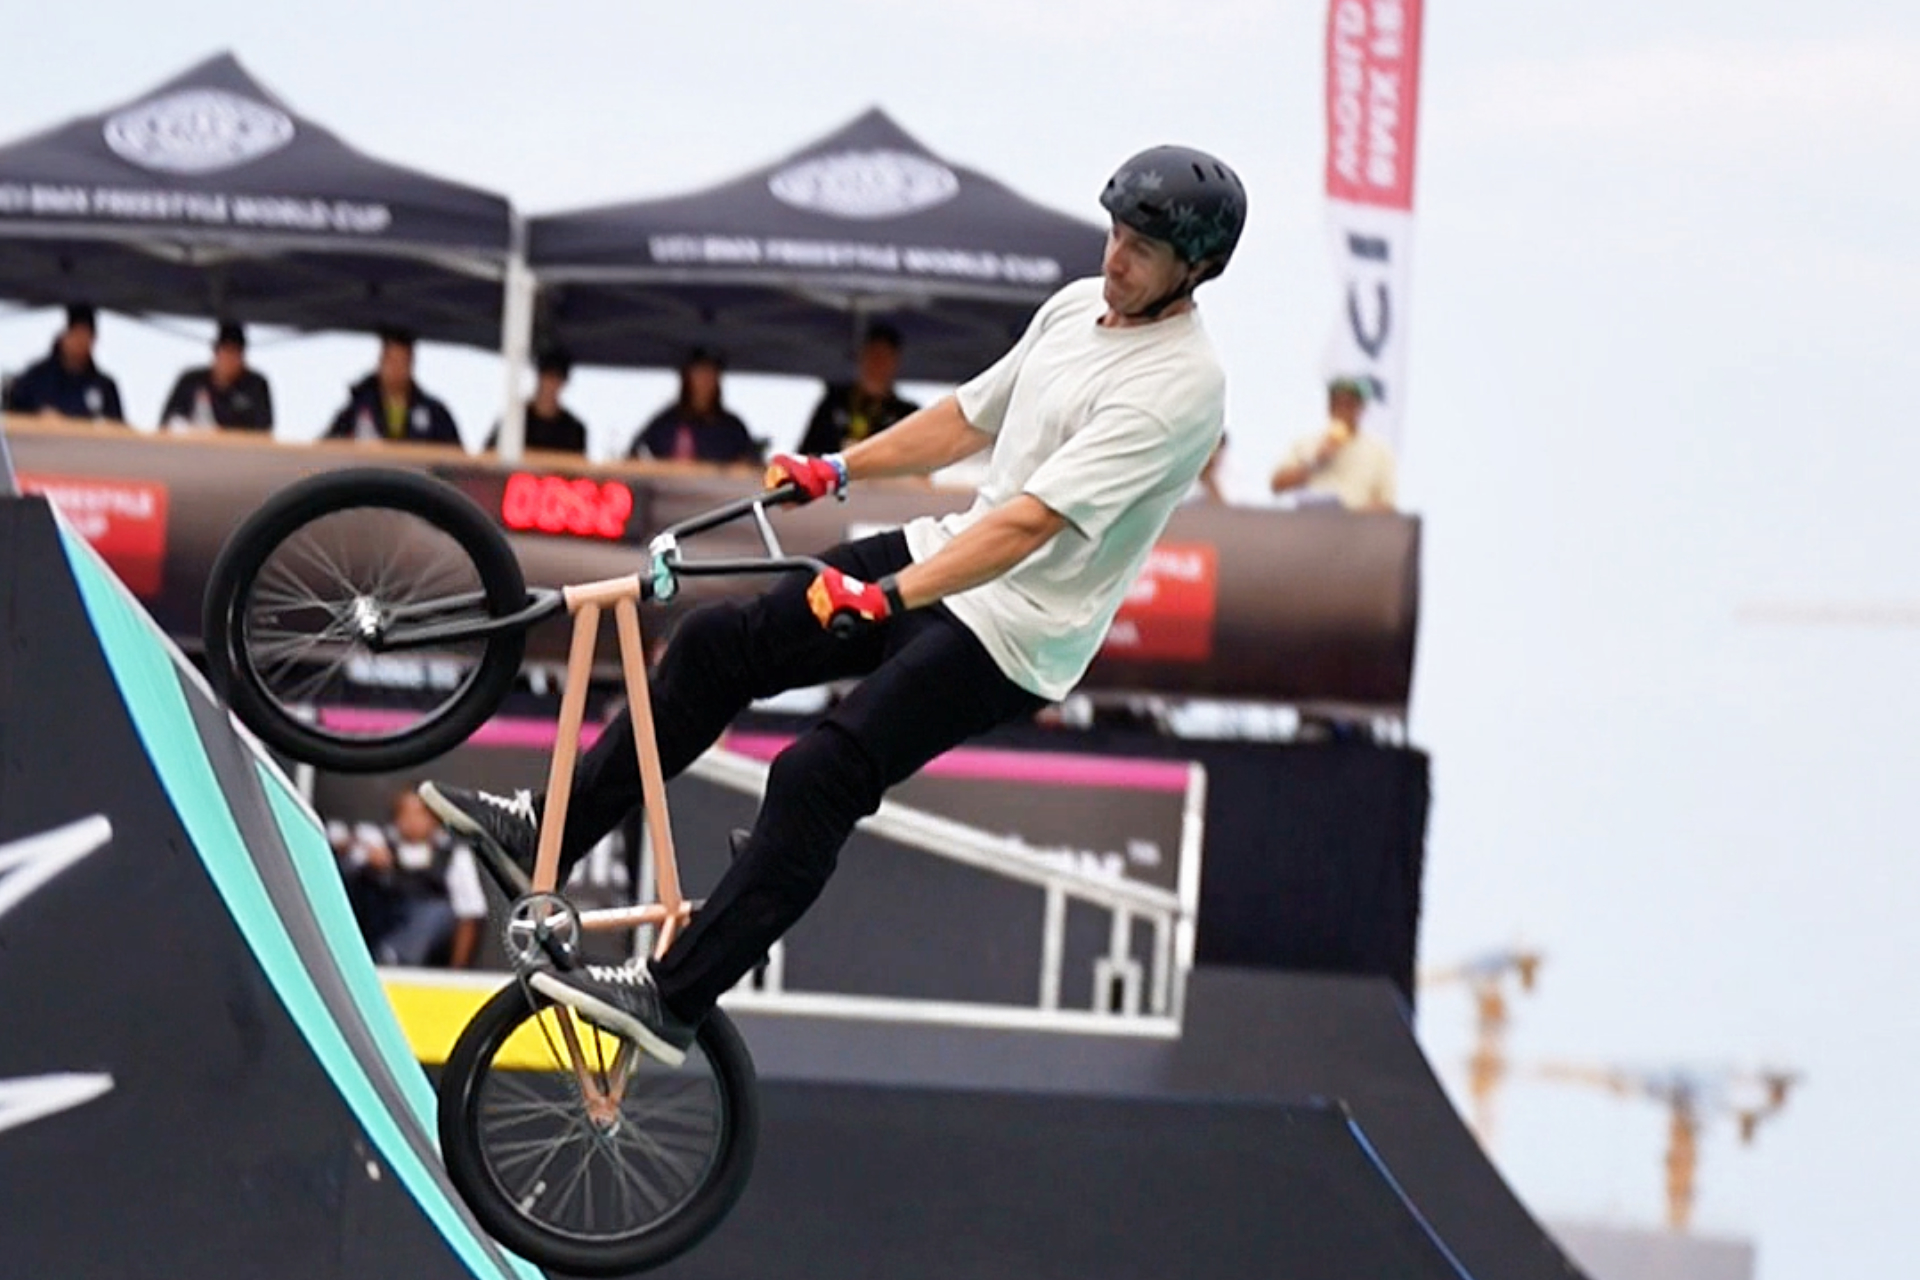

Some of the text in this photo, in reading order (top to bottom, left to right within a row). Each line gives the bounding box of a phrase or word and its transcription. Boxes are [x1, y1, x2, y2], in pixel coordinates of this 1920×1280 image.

[92, 188, 228, 223] FREESTYLE
[232, 196, 331, 230] WORLD
[332, 201, 392, 232] CUP
[765, 239, 898, 269] FREESTYLE
[903, 248, 1001, 277] WORLD
[1002, 254, 1062, 282] CUP
